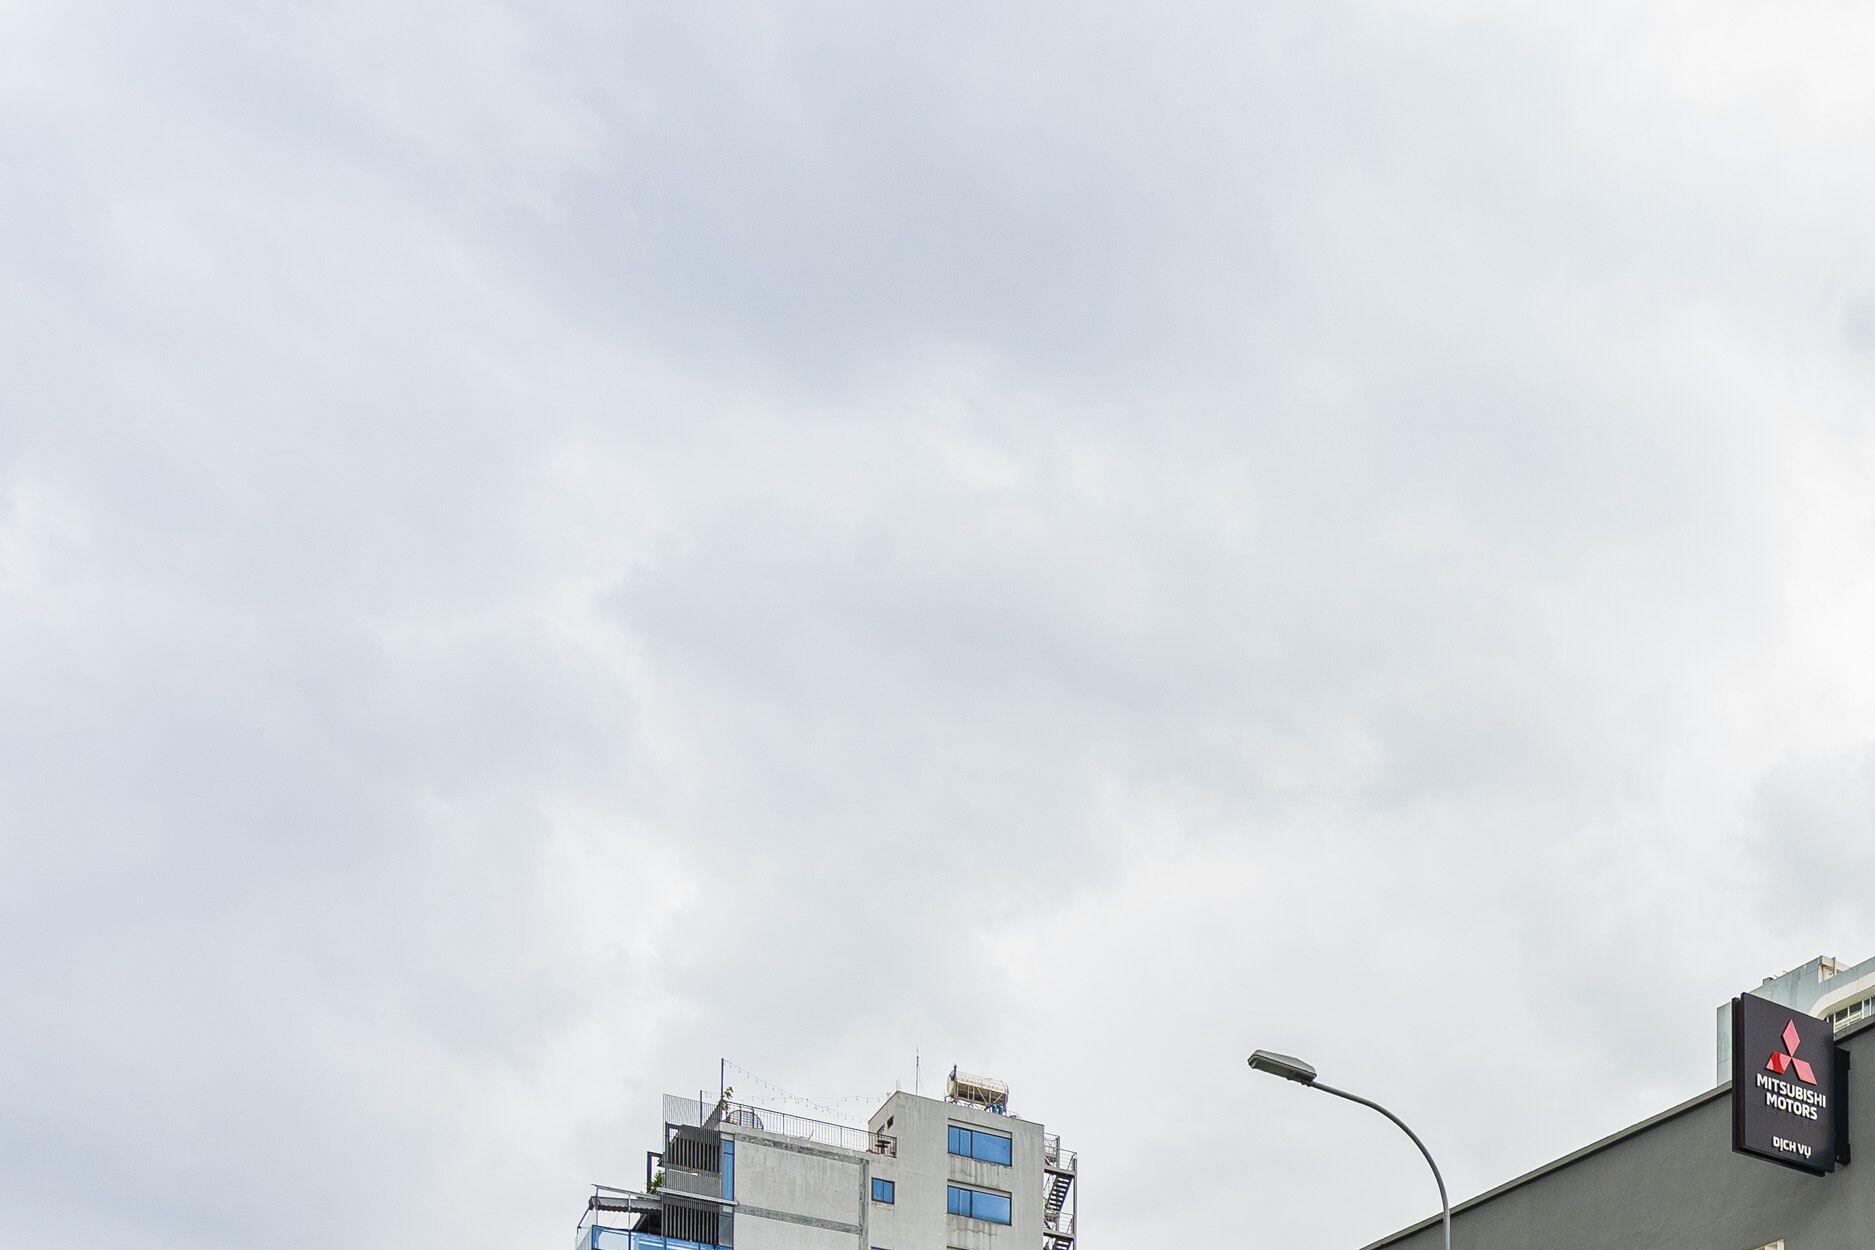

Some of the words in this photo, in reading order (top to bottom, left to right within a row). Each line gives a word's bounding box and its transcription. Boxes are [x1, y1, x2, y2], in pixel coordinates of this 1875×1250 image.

[1757, 1073, 1826, 1108] MITSUBISHI
[1766, 1092, 1818, 1120] MOTORS
[1772, 1136, 1796, 1153] DỊCH
[1798, 1143, 1812, 1159] VỤ
